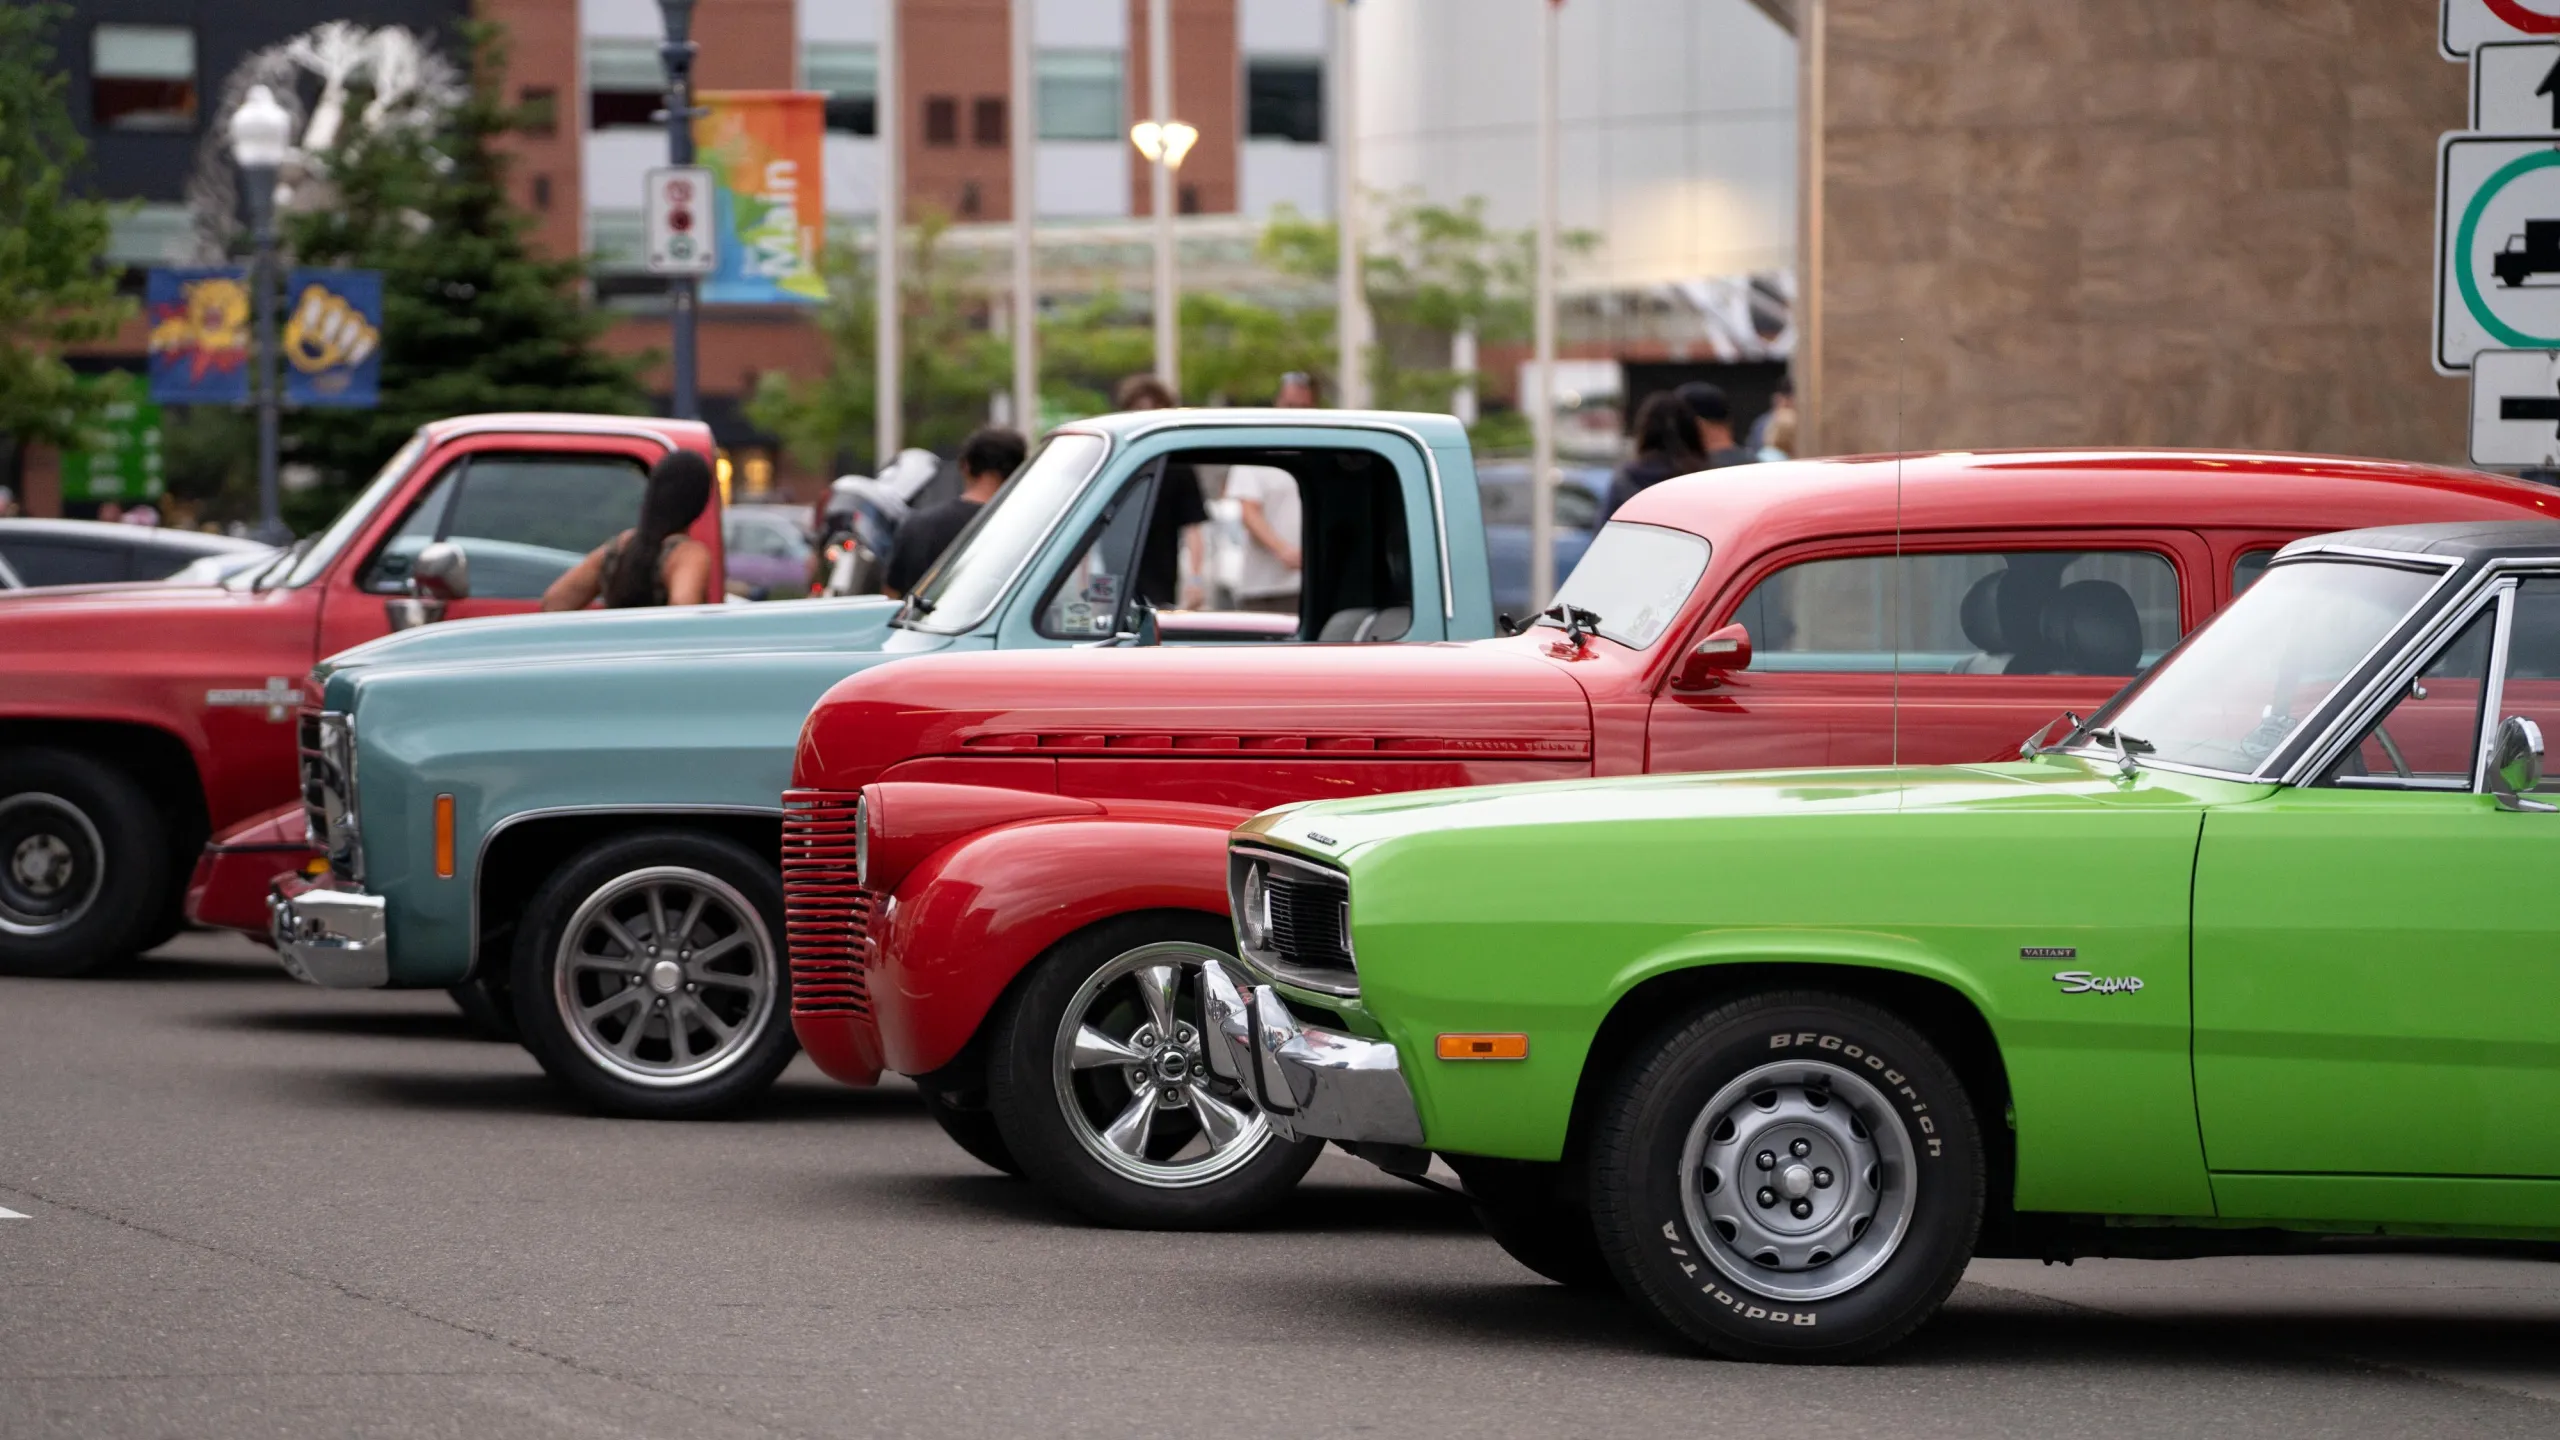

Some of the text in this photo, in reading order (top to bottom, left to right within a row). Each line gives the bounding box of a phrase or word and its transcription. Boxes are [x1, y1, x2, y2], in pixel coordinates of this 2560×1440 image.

[753, 160, 798, 277] Main
[1769, 1032, 1942, 1158] BFGoodrich
[1661, 1219, 1817, 1326] Radial T/A
